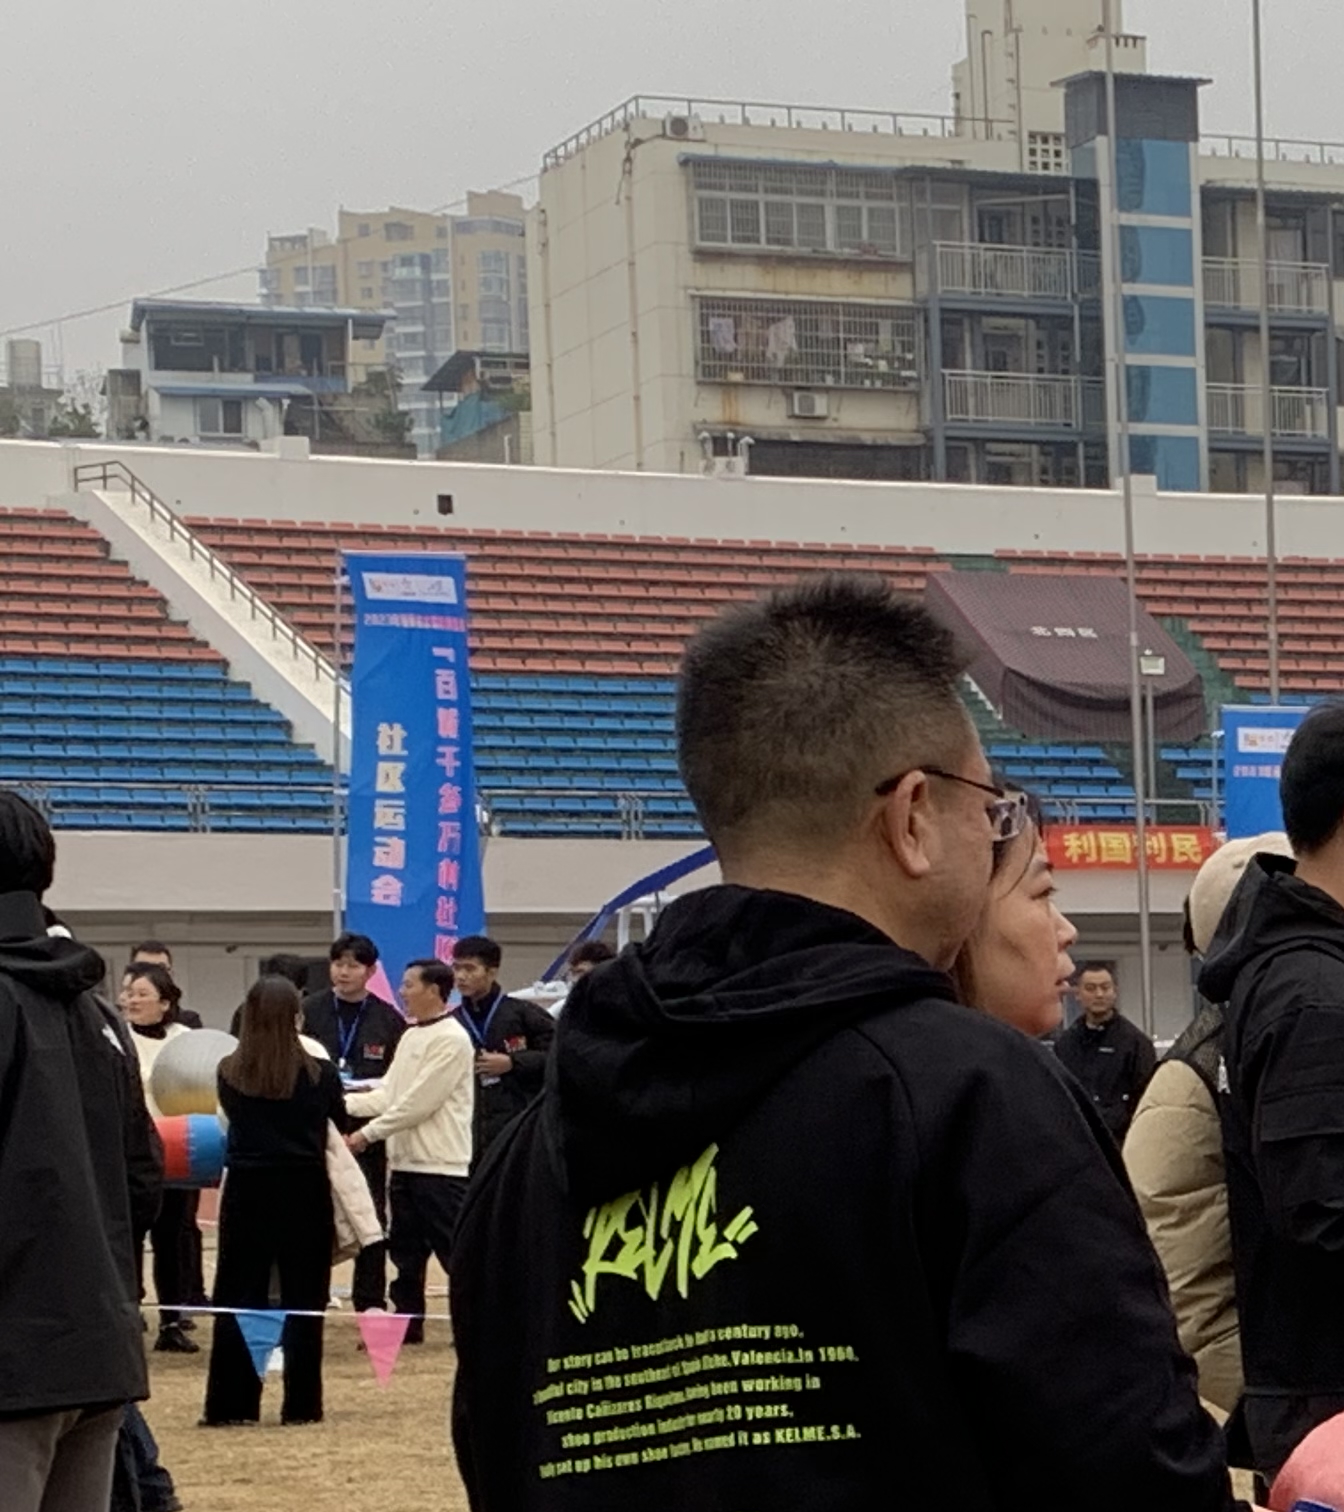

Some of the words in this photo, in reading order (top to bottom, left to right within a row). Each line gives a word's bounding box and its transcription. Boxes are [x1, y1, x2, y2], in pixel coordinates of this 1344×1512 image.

[371, 721, 409, 906] 社区运动会
[717, 1324, 770, 1340] century
[566, 1379, 589, 1395] city
[741, 1375, 802, 1392] working
[806, 1374, 820, 1389] in
[562, 1433, 590, 1448] shoe
[593, 1423, 656, 1445] production
[752, 1432, 771, 1444] as
